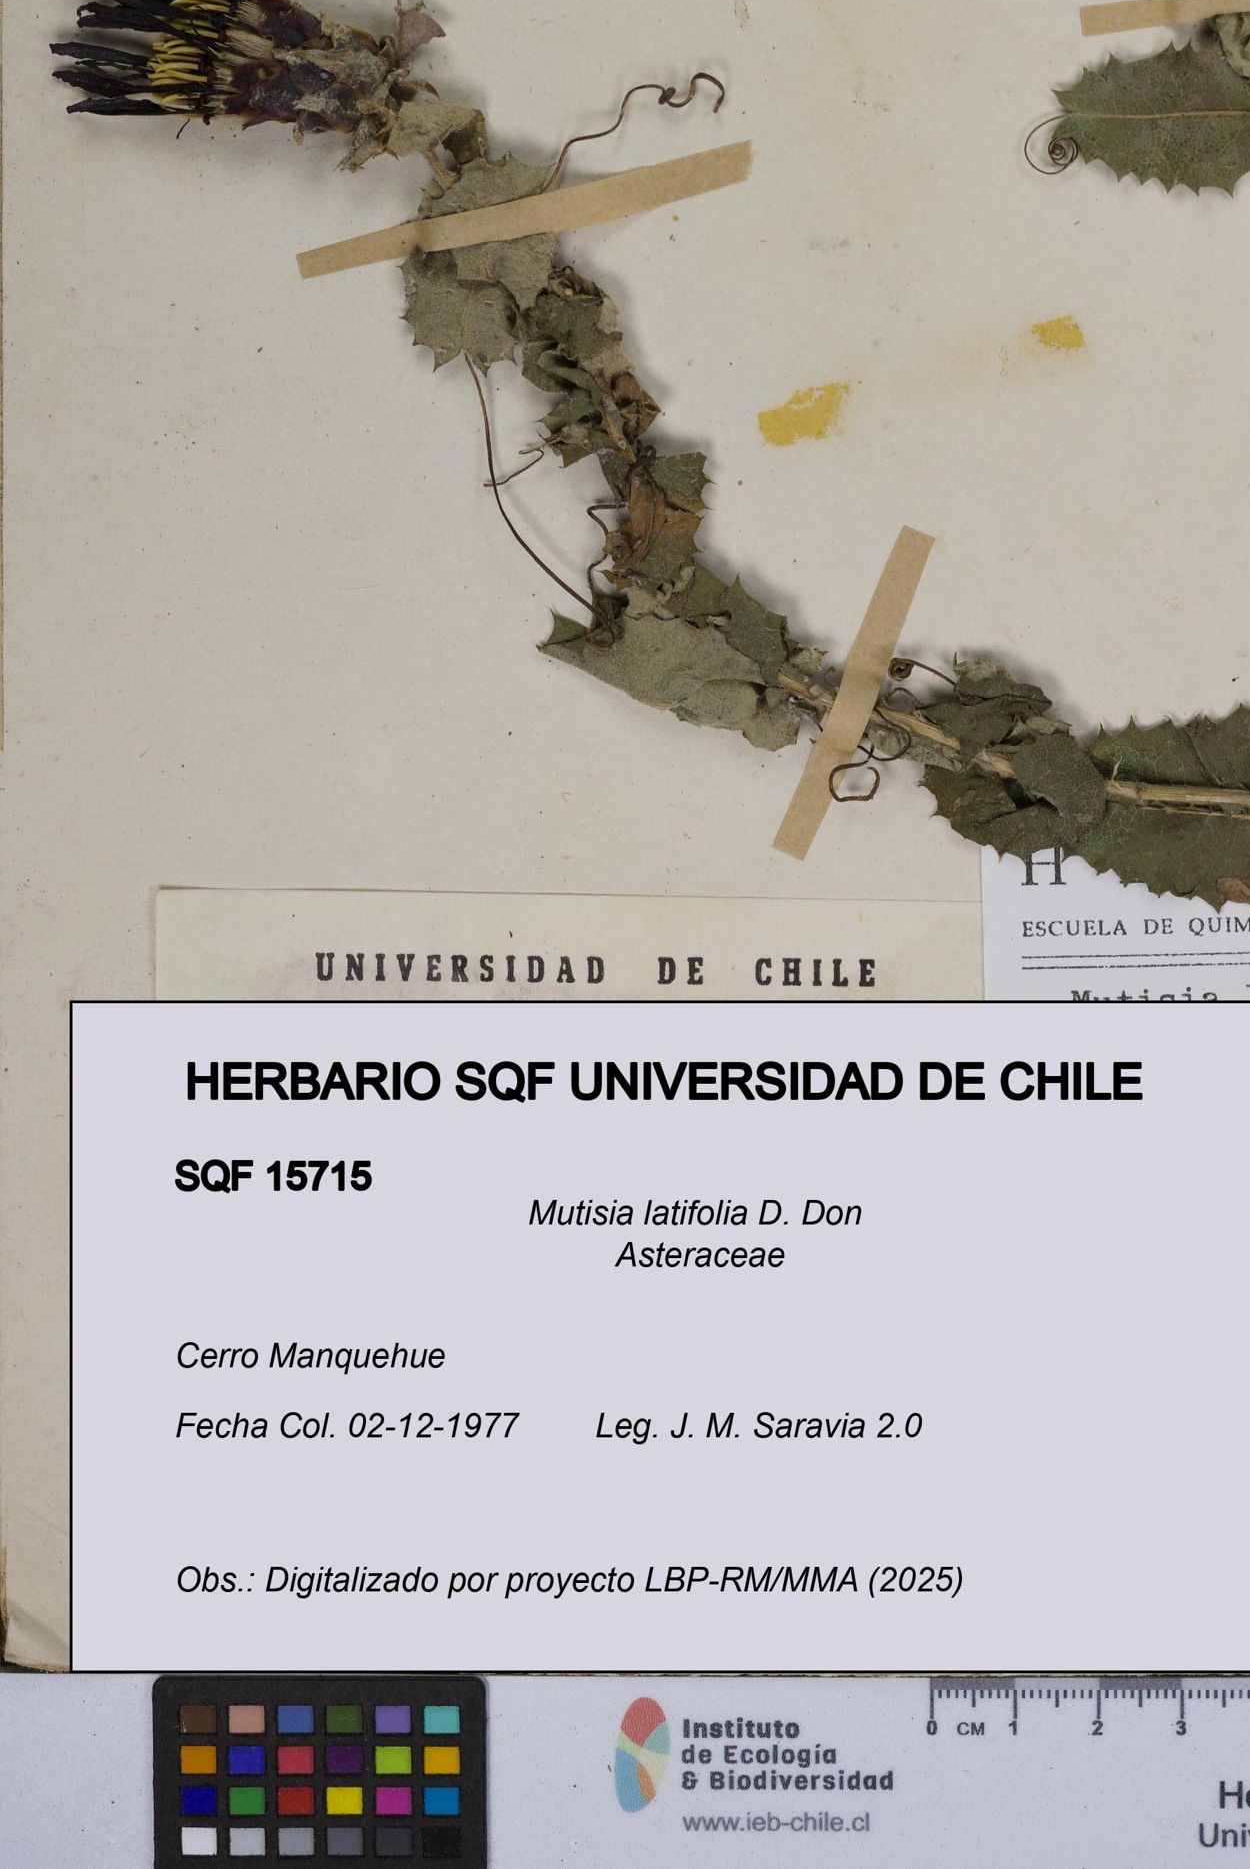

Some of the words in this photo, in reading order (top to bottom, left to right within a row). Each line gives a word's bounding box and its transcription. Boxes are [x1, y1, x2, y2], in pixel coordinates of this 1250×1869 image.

[1022, 919, 1128, 937] ESCUELA
[1143, 918, 1174, 935] DE
[314, 951, 605, 986] UNIVERSIDAD
[656, 956, 704, 986] DE
[754, 957, 879, 988] CHILE
[682, 1717, 801, 1740] Instituto
[926, 1720, 938, 1736] 0
[956, 1721, 985, 1737] CM
[1008, 1720, 1018, 1736] 1
[1091, 1720, 1104, 1736] 2
[1175, 1720, 1187, 1736] 3
[681, 1744, 713, 1766] de
[723, 1743, 837, 1769] Ecología
[681, 1770, 699, 1791] &
[709, 1769, 894, 1791] Biodiversidad
[682, 1811, 870, 1832] www.ieb-chile.cl
